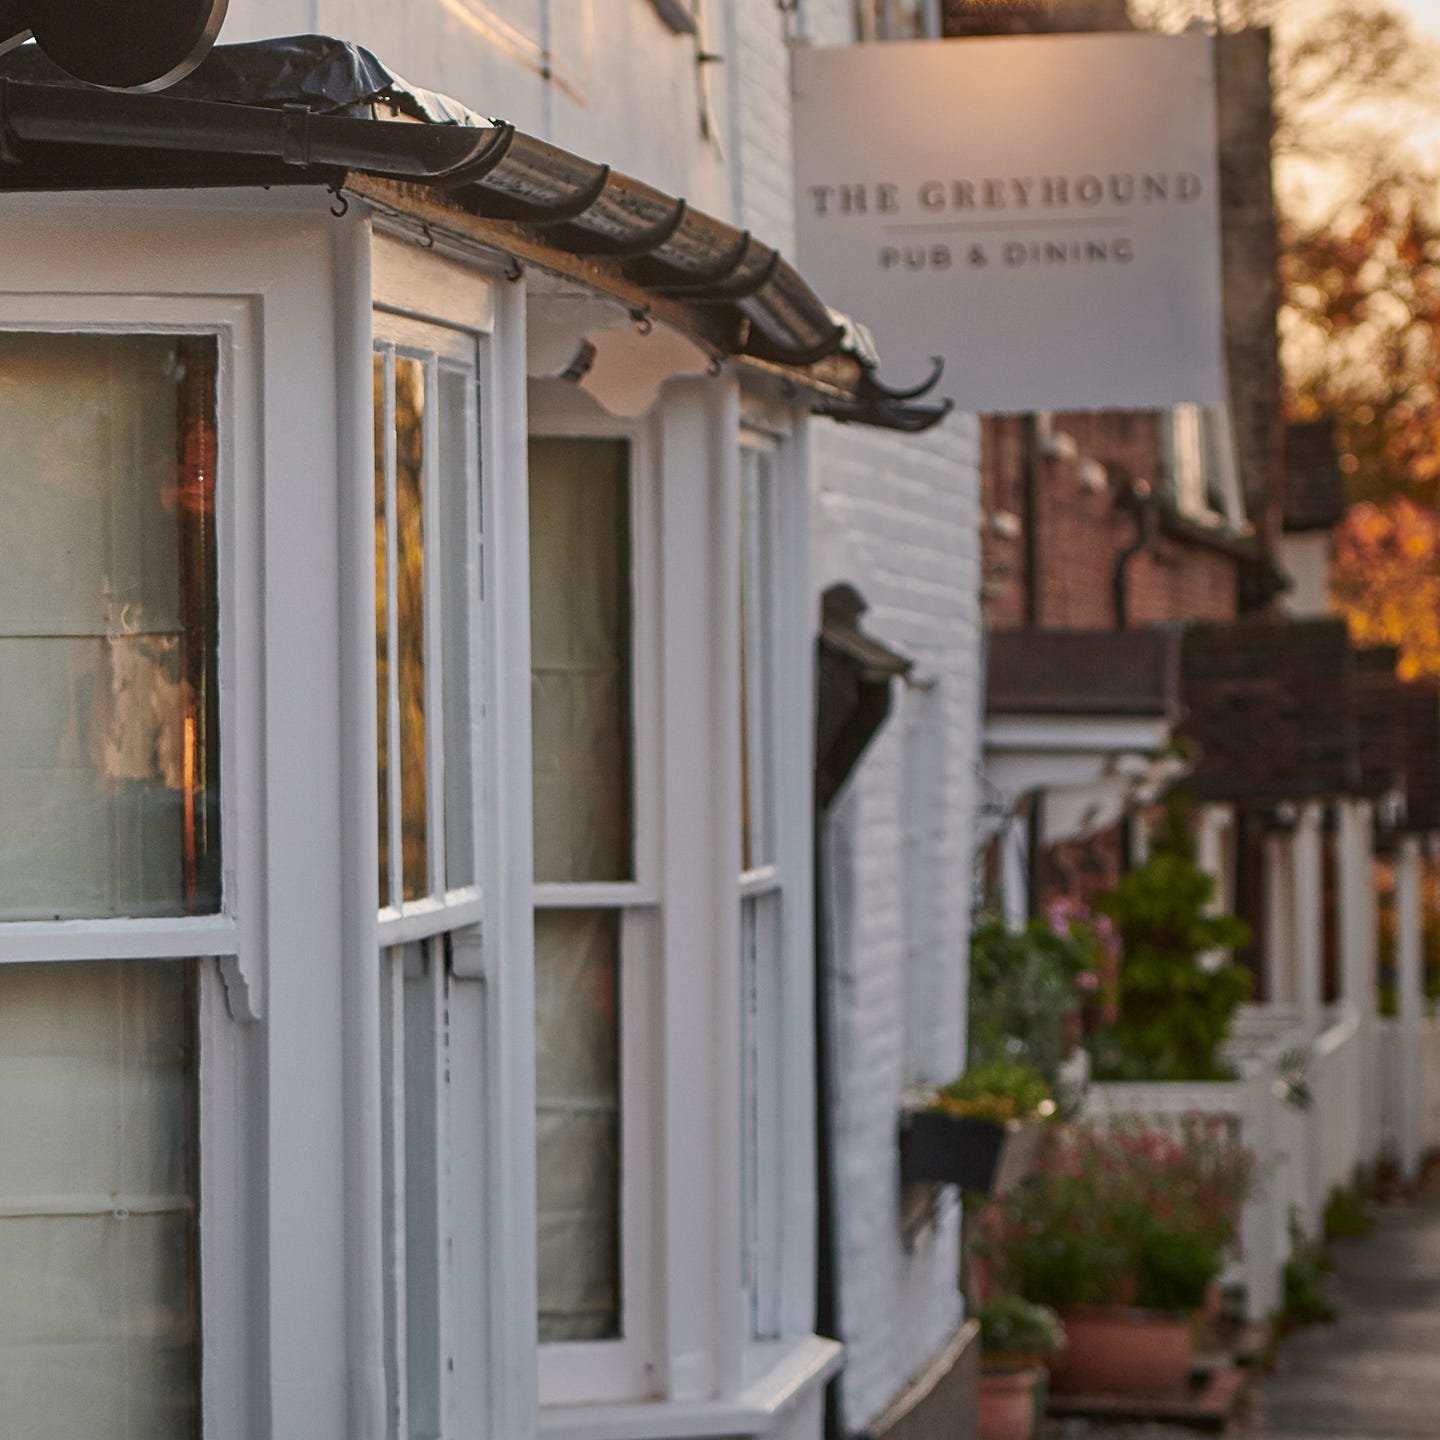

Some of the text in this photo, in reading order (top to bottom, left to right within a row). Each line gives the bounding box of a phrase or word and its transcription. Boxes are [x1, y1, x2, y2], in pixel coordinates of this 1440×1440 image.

[809, 172, 1203, 217] THE GREYHOUND
[878, 236, 1135, 272] PUB & DINING
